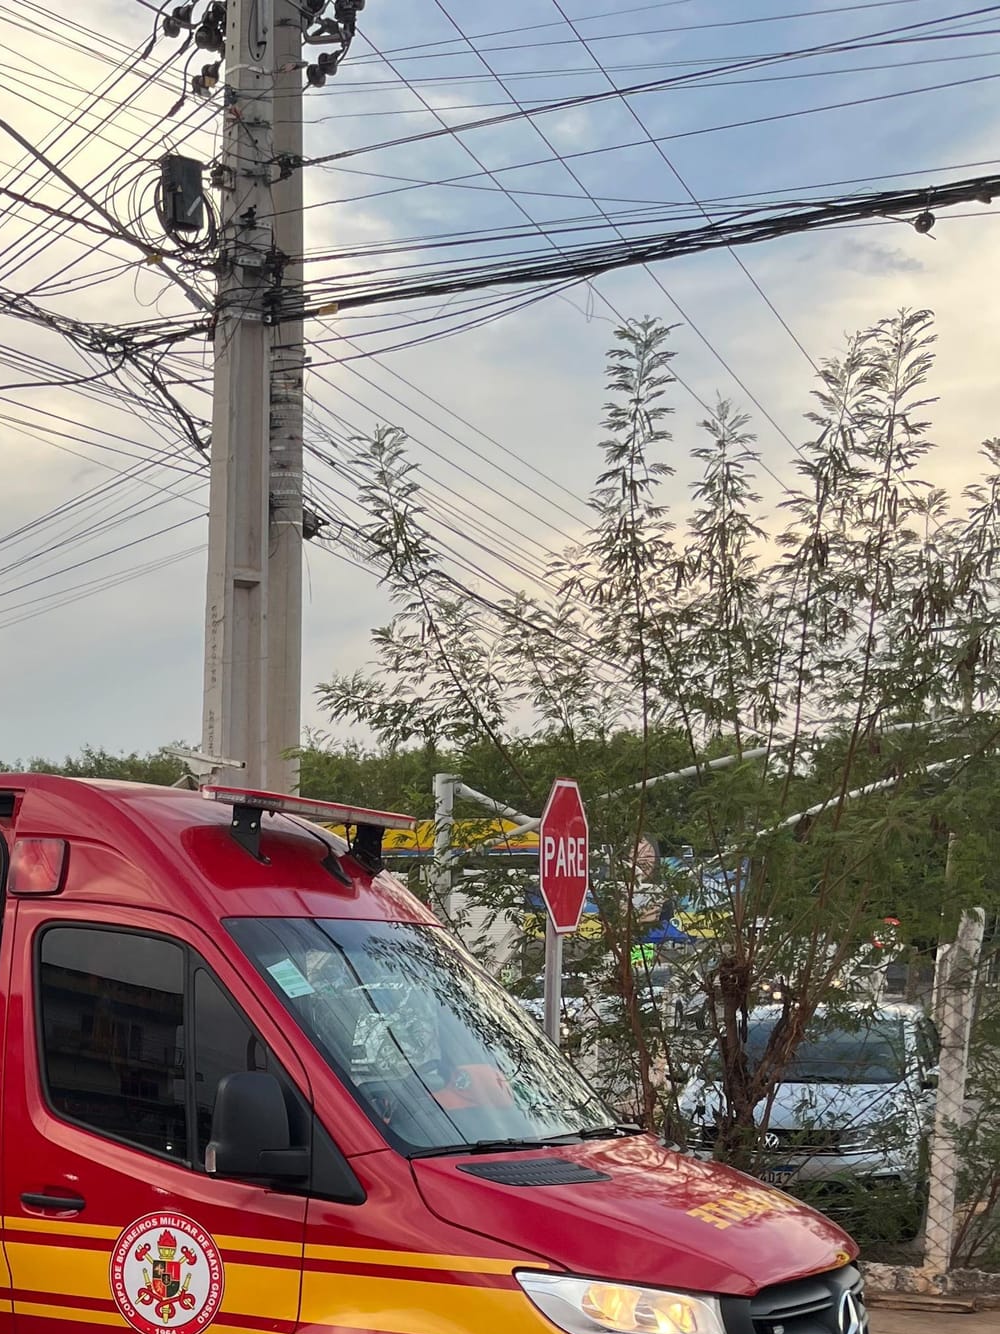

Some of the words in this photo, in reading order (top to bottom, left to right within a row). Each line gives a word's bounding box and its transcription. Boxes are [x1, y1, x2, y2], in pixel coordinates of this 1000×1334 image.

[543, 836, 586, 878] PARE
[117, 1218, 158, 1263] BOMBEIROS
[160, 1217, 198, 1236] MILITAR
[197, 1234, 209, 1248] DE
[114, 1265, 122, 1280] DE
[206, 1249, 220, 1280] MATO
[114, 1283, 135, 1317] CORPO
[196, 1284, 220, 1324] GROSSO
